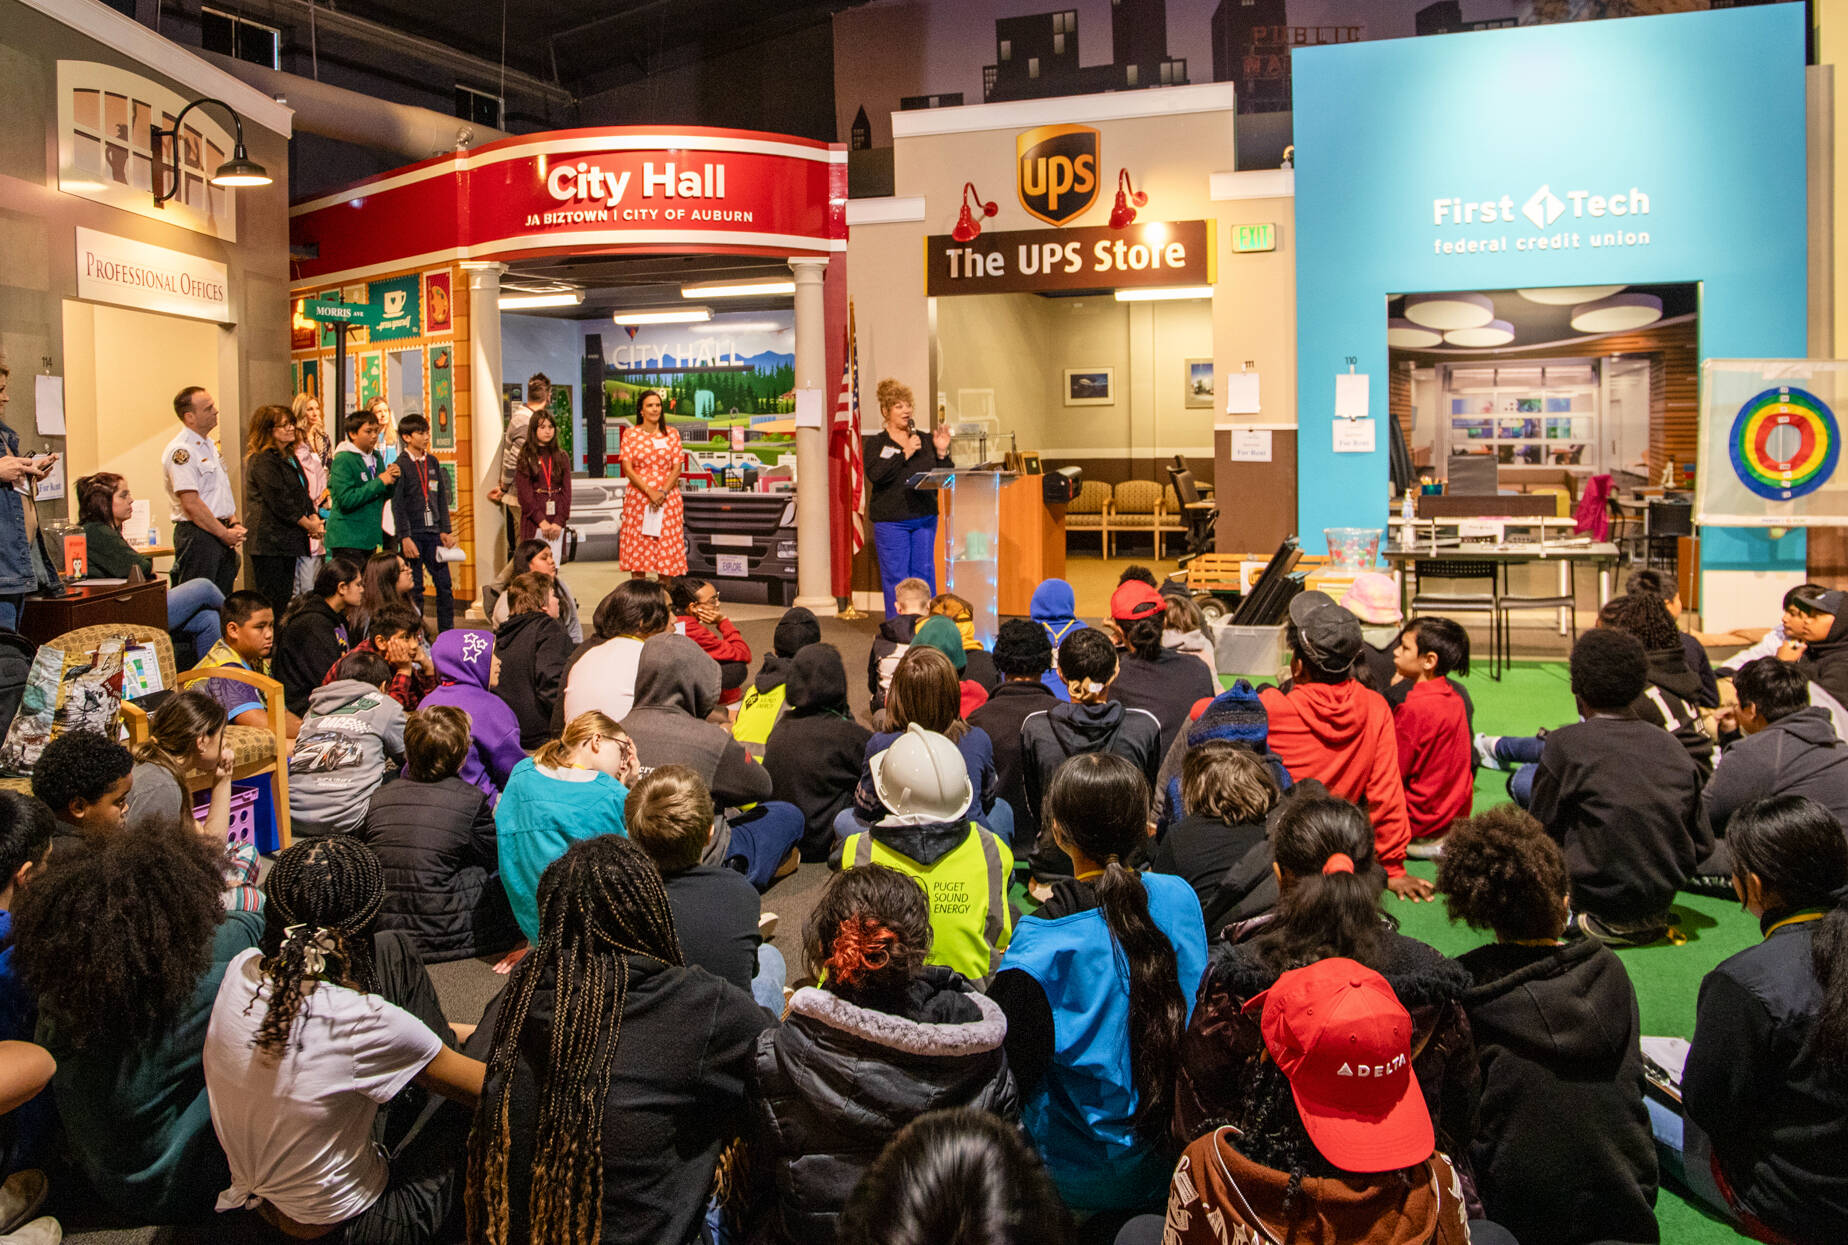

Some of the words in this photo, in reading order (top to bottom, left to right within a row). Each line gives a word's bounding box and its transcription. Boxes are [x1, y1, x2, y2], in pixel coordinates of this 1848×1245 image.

[547, 162, 631, 206] City
[643, 162, 725, 198] Hall
[525, 214, 541, 226] JA
[543, 209, 608, 225] BIZTOWN
[622, 208, 658, 221] CITY
[664, 209, 686, 221] OF
[691, 209, 754, 223] AUBURN
[1433, 194, 1515, 225] First
[1567, 187, 1650, 218] Tech
[1239, 225, 1269, 250] EXIT
[1434, 236, 1507, 254] federal
[1515, 231, 1581, 251] credit
[1589, 230, 1650, 248] union
[946, 246, 1005, 278] The
[1018, 242, 1083, 275] UPS
[1094, 238, 1187, 272] Store
[86, 251, 177, 293] PROFESSIONAL
[180, 272, 224, 302] OFFICES
[316, 306, 352, 318] MORRIS
[612, 343, 668, 370] CITY
[675, 342, 745, 368] HALL
[1244, 360, 1255, 368] 111
[1345, 356, 1358, 365] 110
[933, 882, 965, 892] PUGET
[933, 893, 969, 903] SOUND
[933, 904, 971, 914] ENERGY
[1358, 1053, 1406, 1078] DELTA
